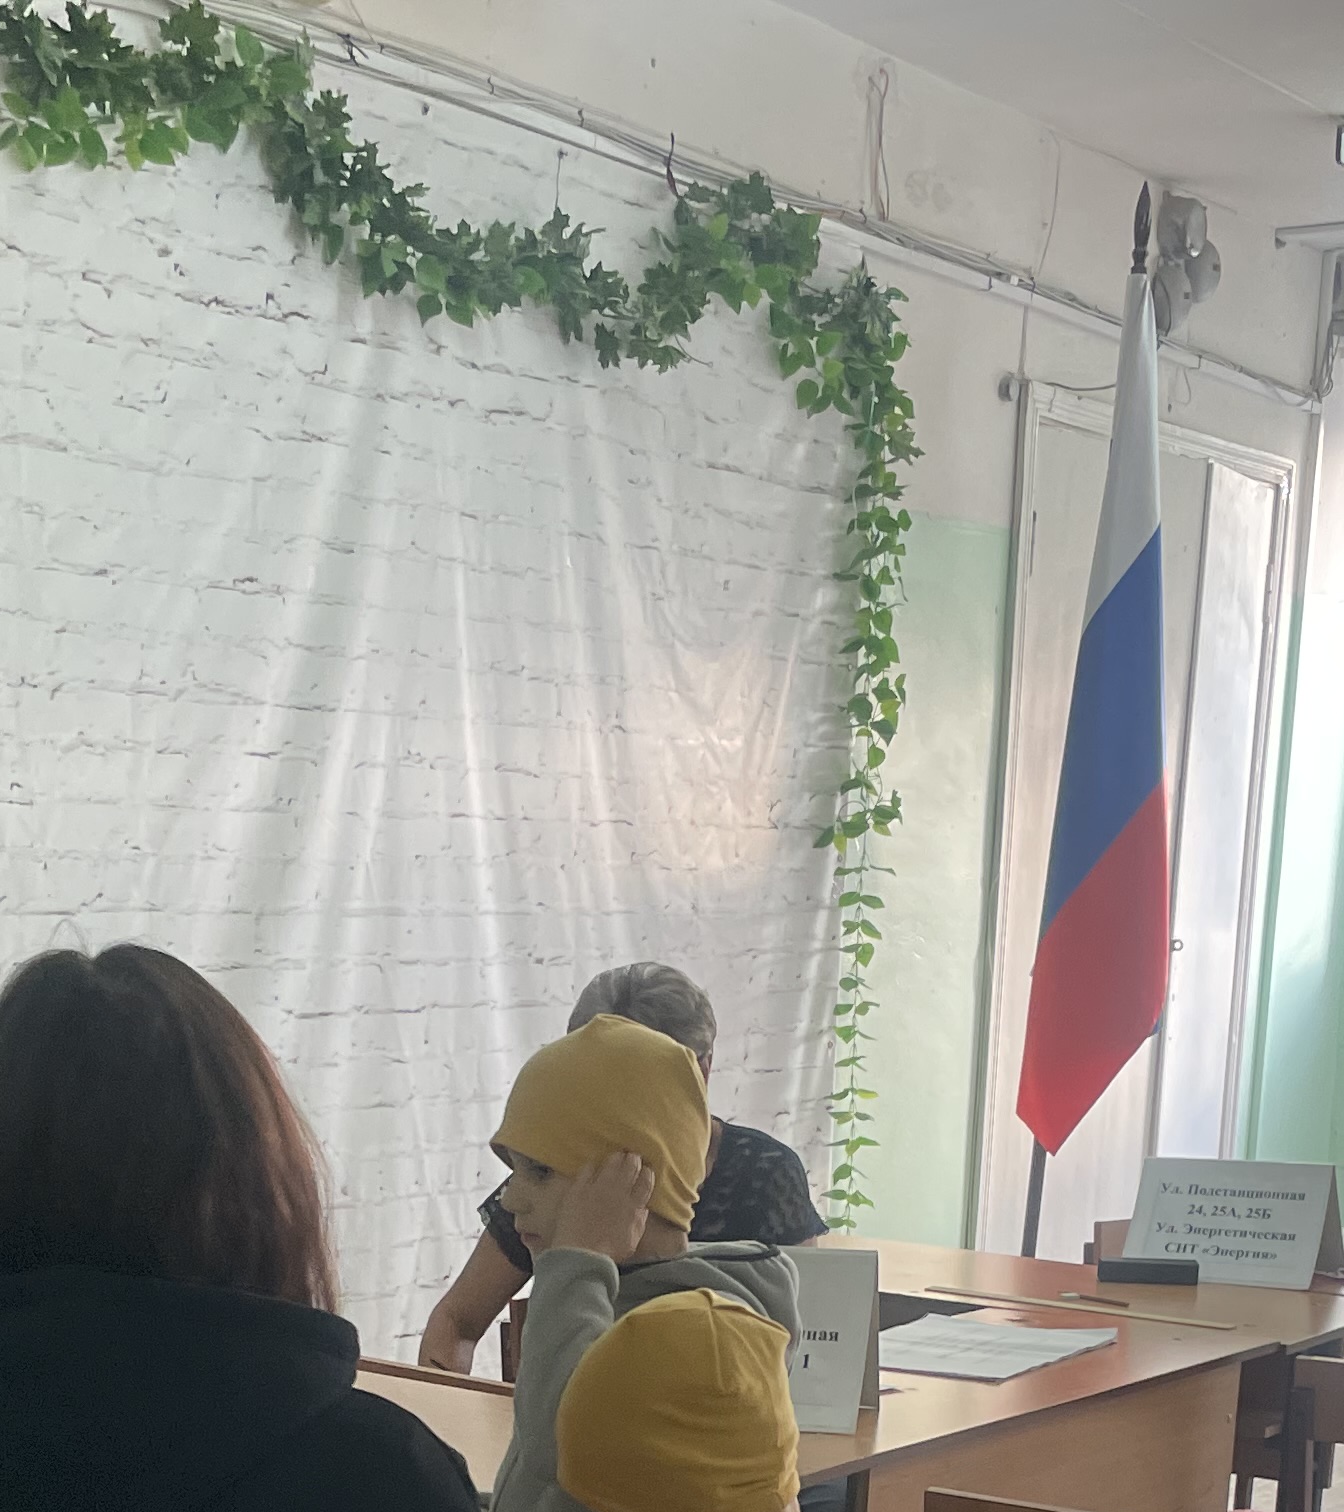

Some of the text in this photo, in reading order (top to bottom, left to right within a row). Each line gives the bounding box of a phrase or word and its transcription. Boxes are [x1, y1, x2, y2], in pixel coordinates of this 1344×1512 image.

[1160, 1182, 1306, 1201] Ул. Подстанционная
[1187, 1204, 1208, 1217] 24,
[1156, 1222, 1297, 1242] Ул. Энергетическая
[1164, 1241, 1278, 1261] СНТ «Энергия»
